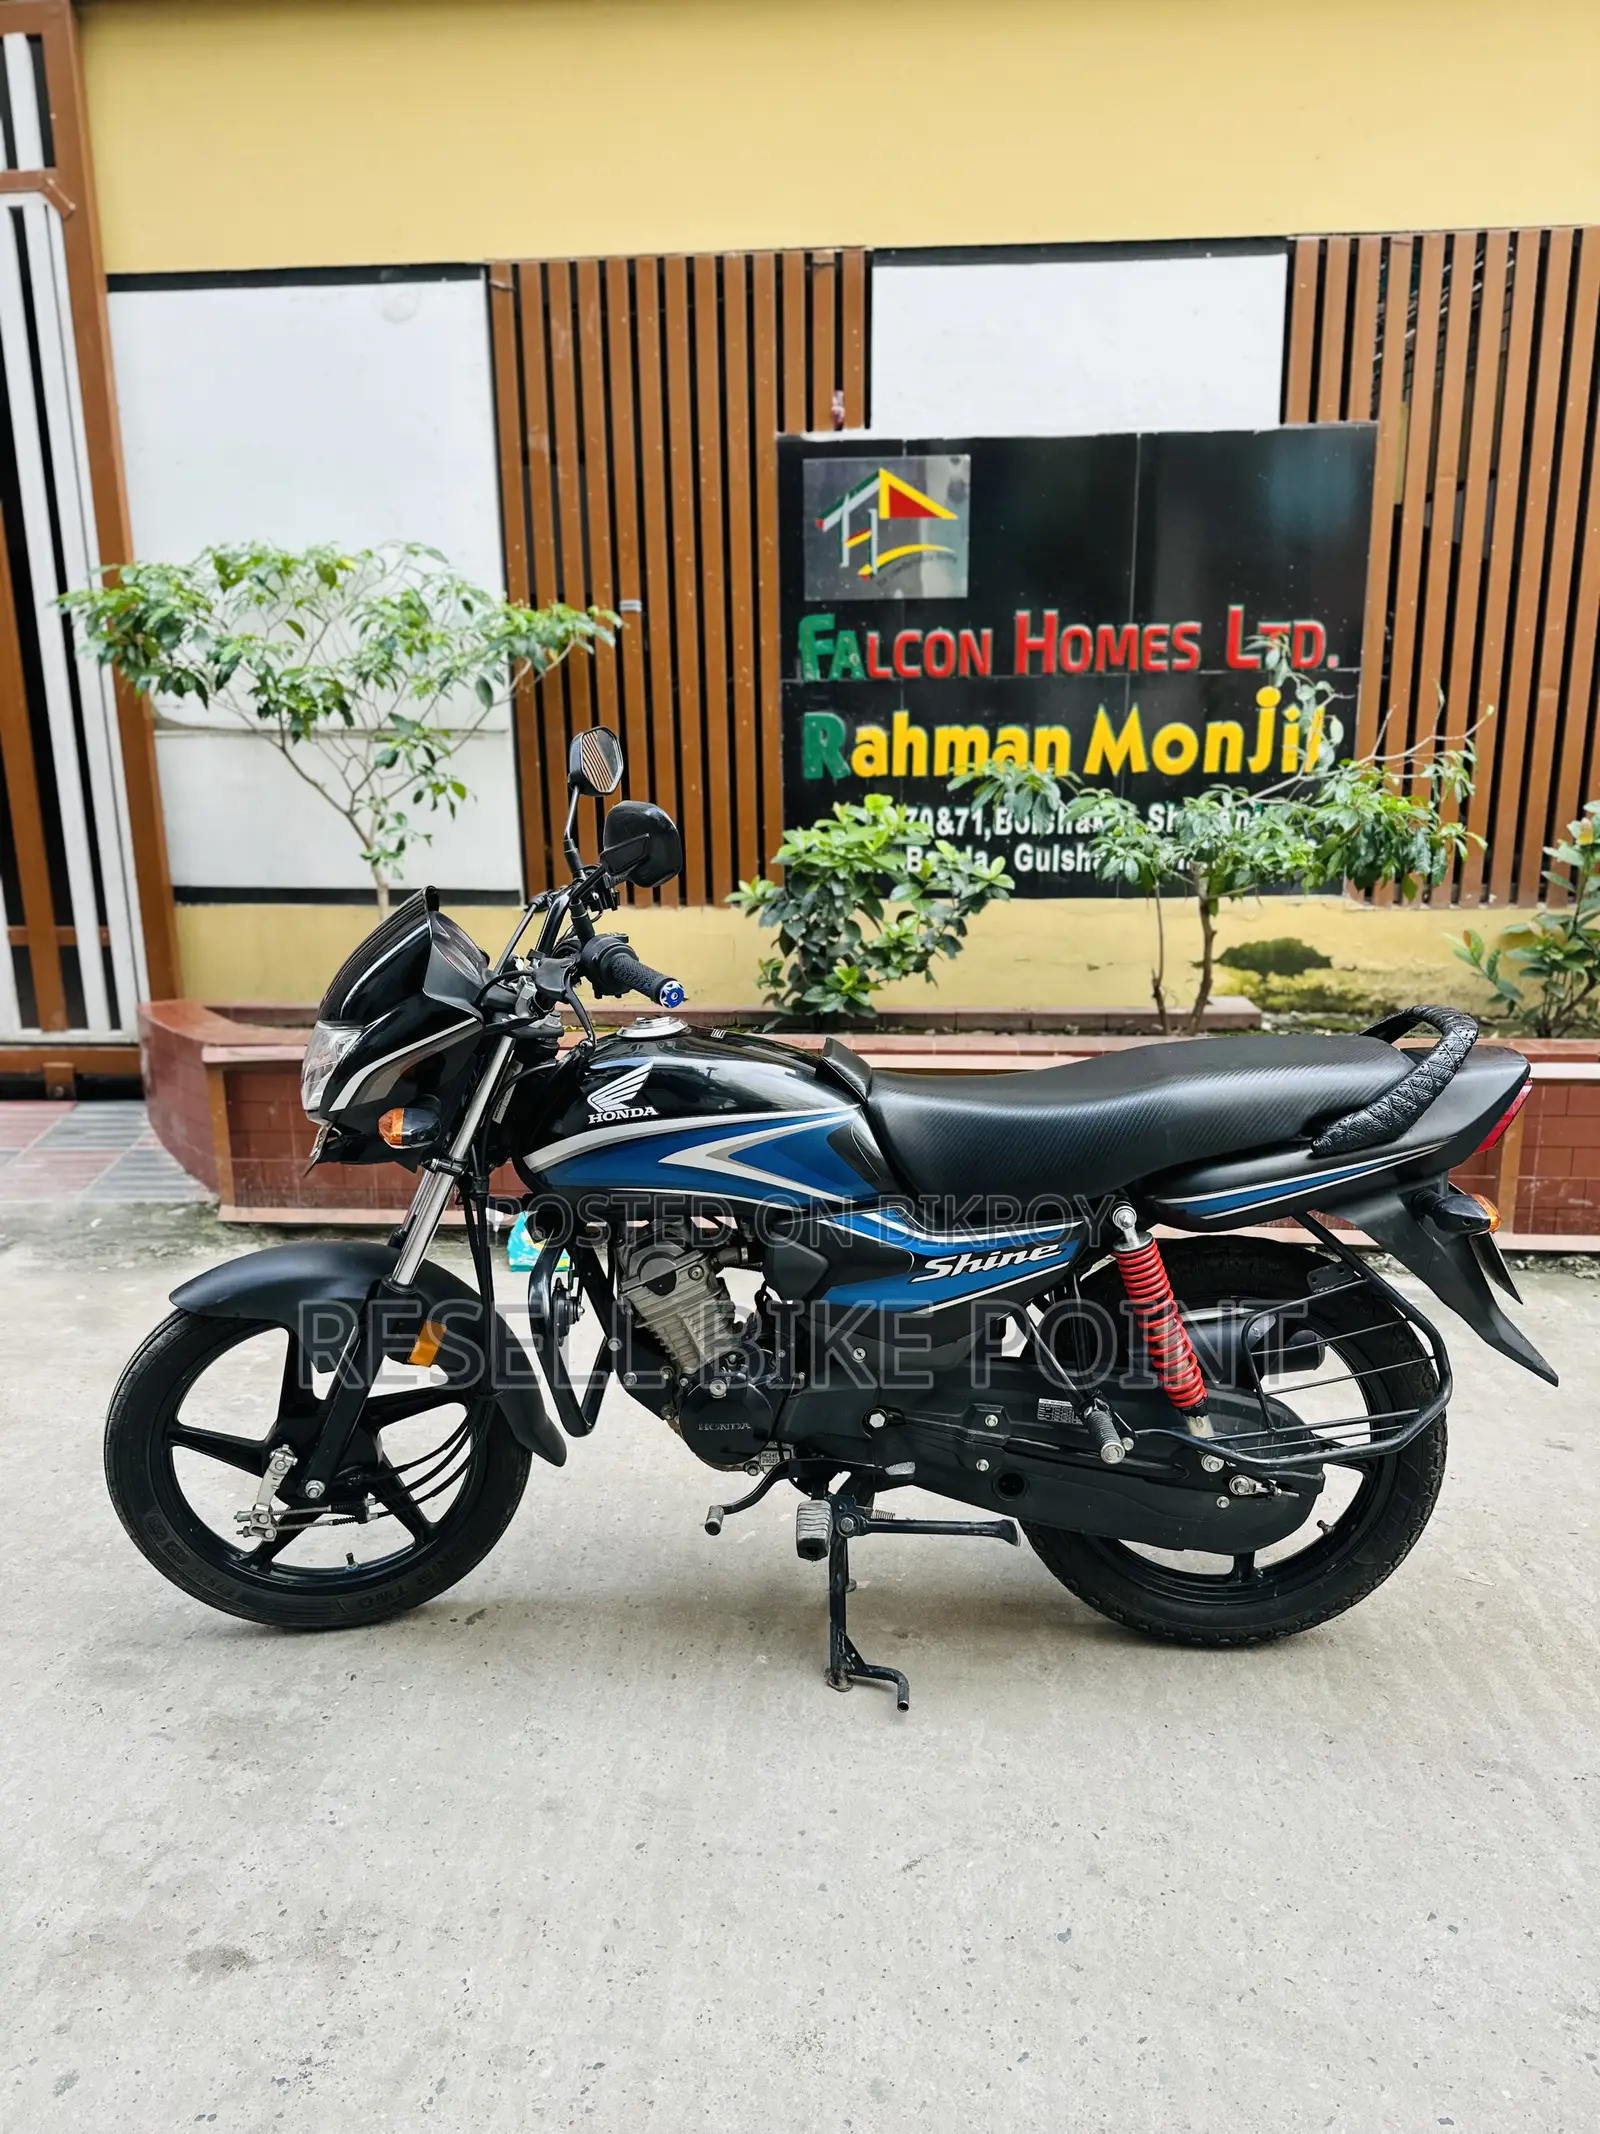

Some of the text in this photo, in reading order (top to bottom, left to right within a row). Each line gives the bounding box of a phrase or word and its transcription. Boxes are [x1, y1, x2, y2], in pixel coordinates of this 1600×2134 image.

[798, 612, 993, 682] FALCON
[1014, 608, 1202, 675] HOMES
[803, 709, 1072, 780] Rahman
[587, 1106, 659, 1124] HONDA
[909, 1243, 1064, 1284] Shine
[697, 1422, 752, 1431] HONDA
